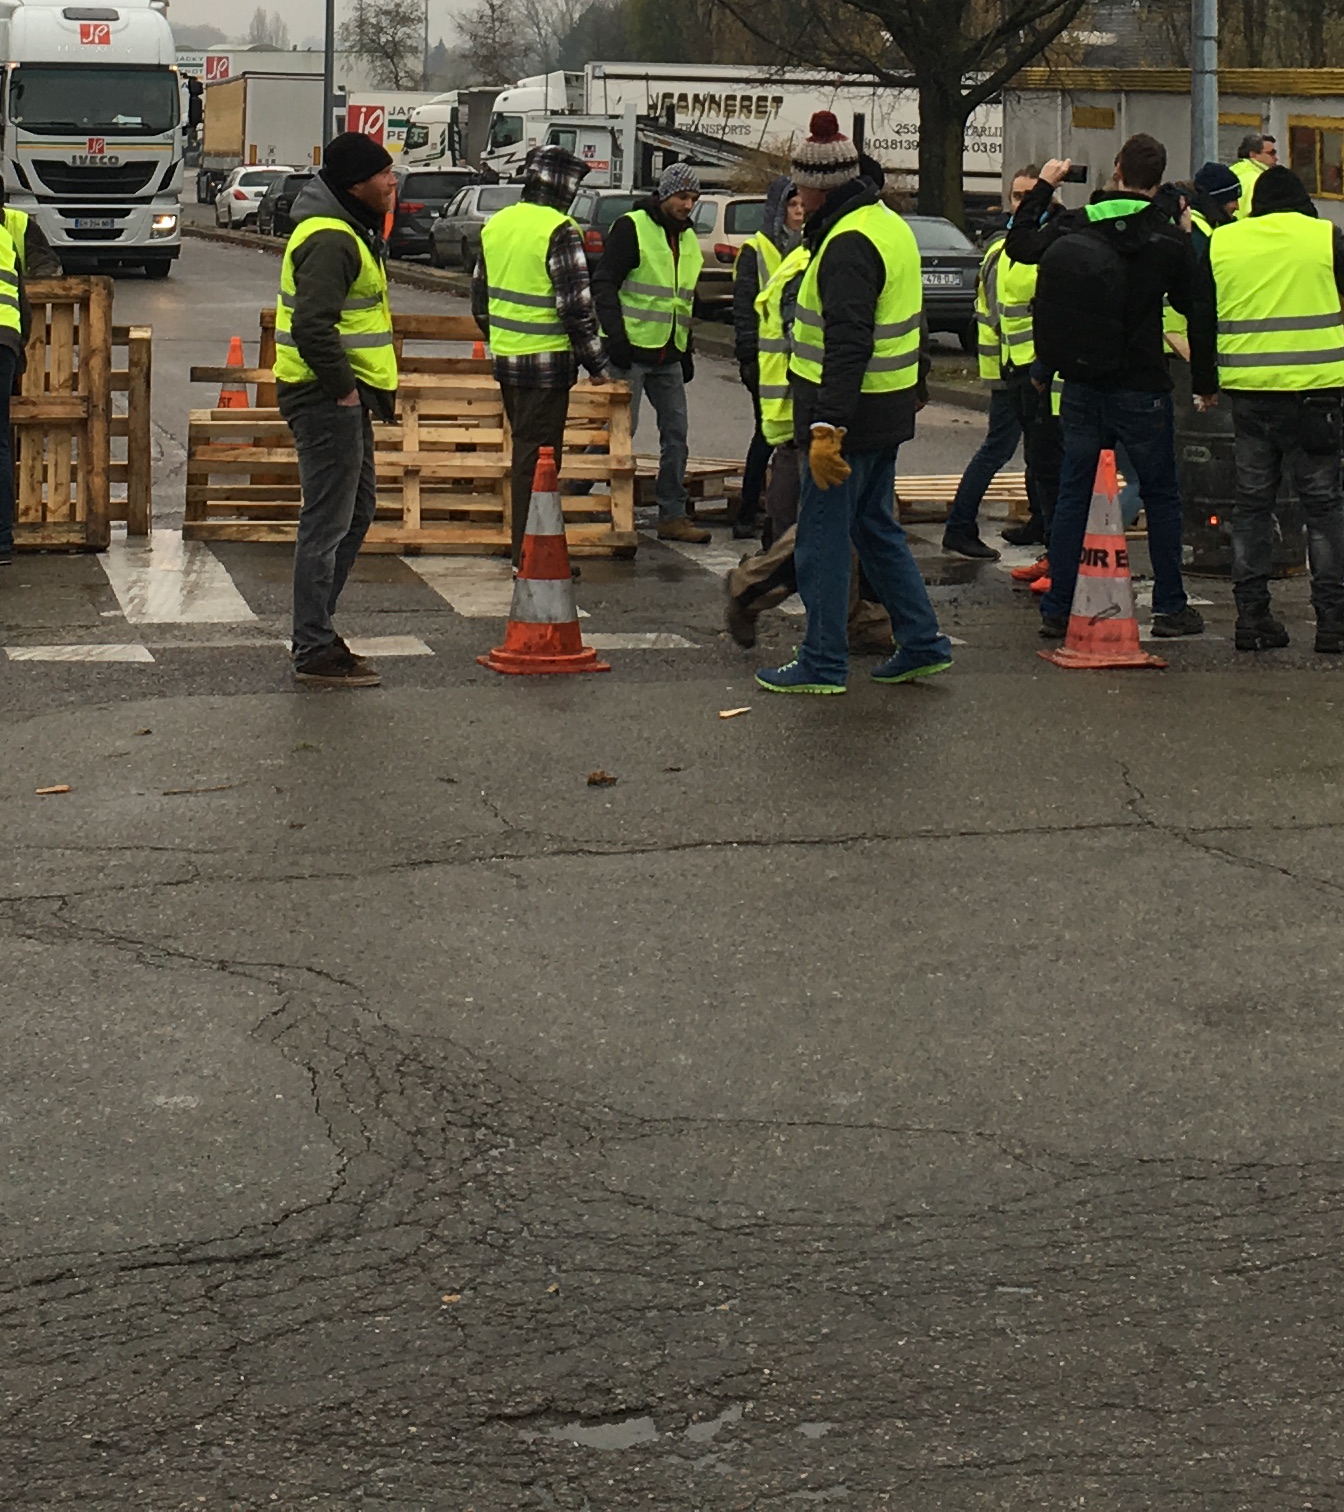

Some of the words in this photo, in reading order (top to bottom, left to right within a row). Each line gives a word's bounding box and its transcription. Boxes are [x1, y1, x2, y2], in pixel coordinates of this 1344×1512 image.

[677, 122, 751, 135] TRANSPORTS
[896, 123, 919, 135] 253
[72, 155, 119, 166] IVECO
